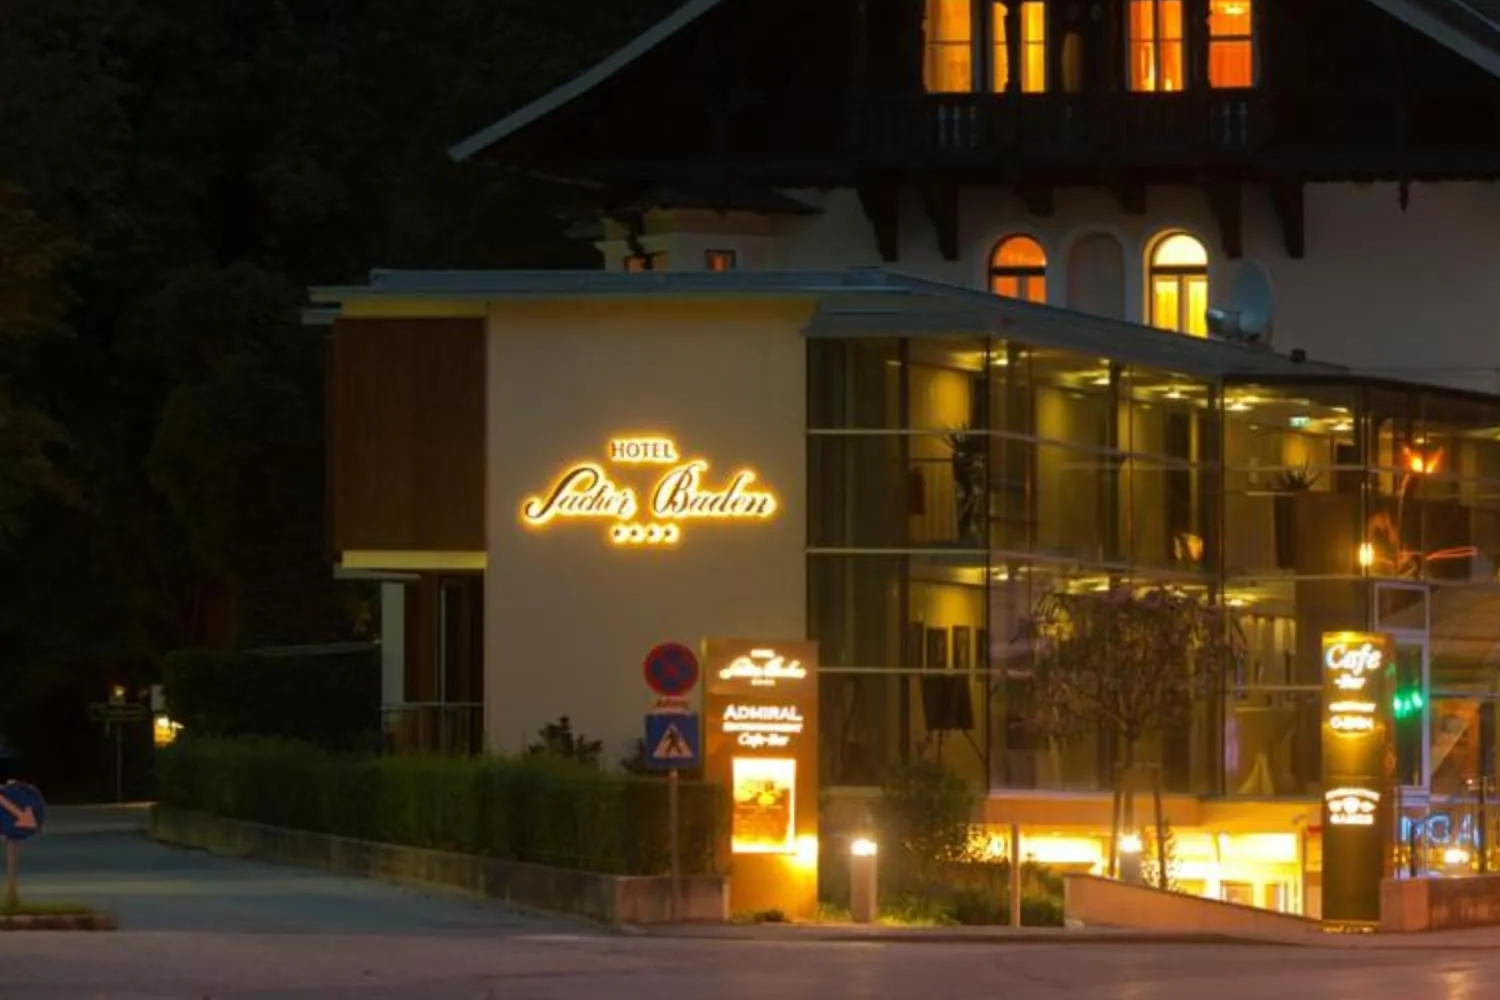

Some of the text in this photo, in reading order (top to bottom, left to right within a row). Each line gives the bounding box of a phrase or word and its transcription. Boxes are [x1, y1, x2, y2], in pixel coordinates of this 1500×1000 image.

[609, 440, 677, 460] HOTEL
[523, 461, 774, 520] Sacher Baden
[1326, 642, 1382, 675] Cafe
[723, 704, 804, 721] ADMIRAL
